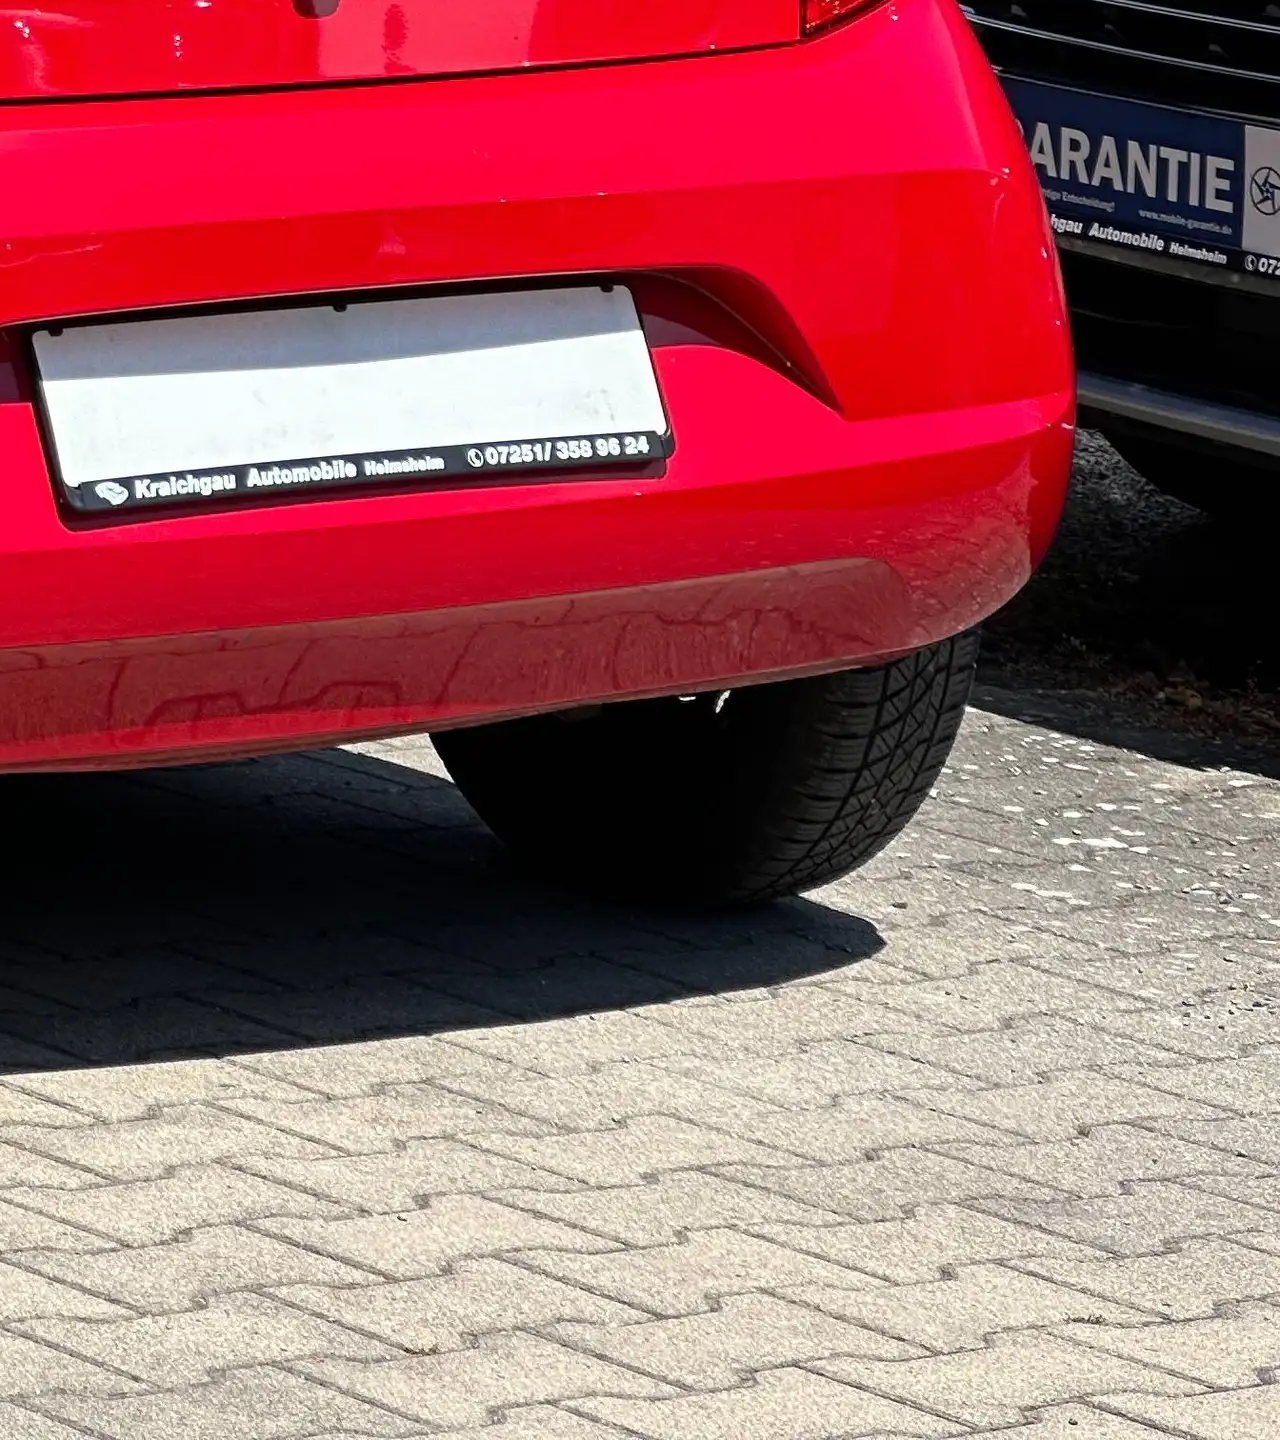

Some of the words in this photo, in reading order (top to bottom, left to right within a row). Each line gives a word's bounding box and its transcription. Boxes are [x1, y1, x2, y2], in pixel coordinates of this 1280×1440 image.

[1016, 118, 1236, 214] ARANTIE
[1088, 222, 1165, 251] Automobile
[135, 474, 237, 500] Kraichgau
[247, 460, 358, 488] Automobile
[555, 439, 593, 460] 358
[596, 437, 621, 457] 96
[624, 435, 650, 455] 24
